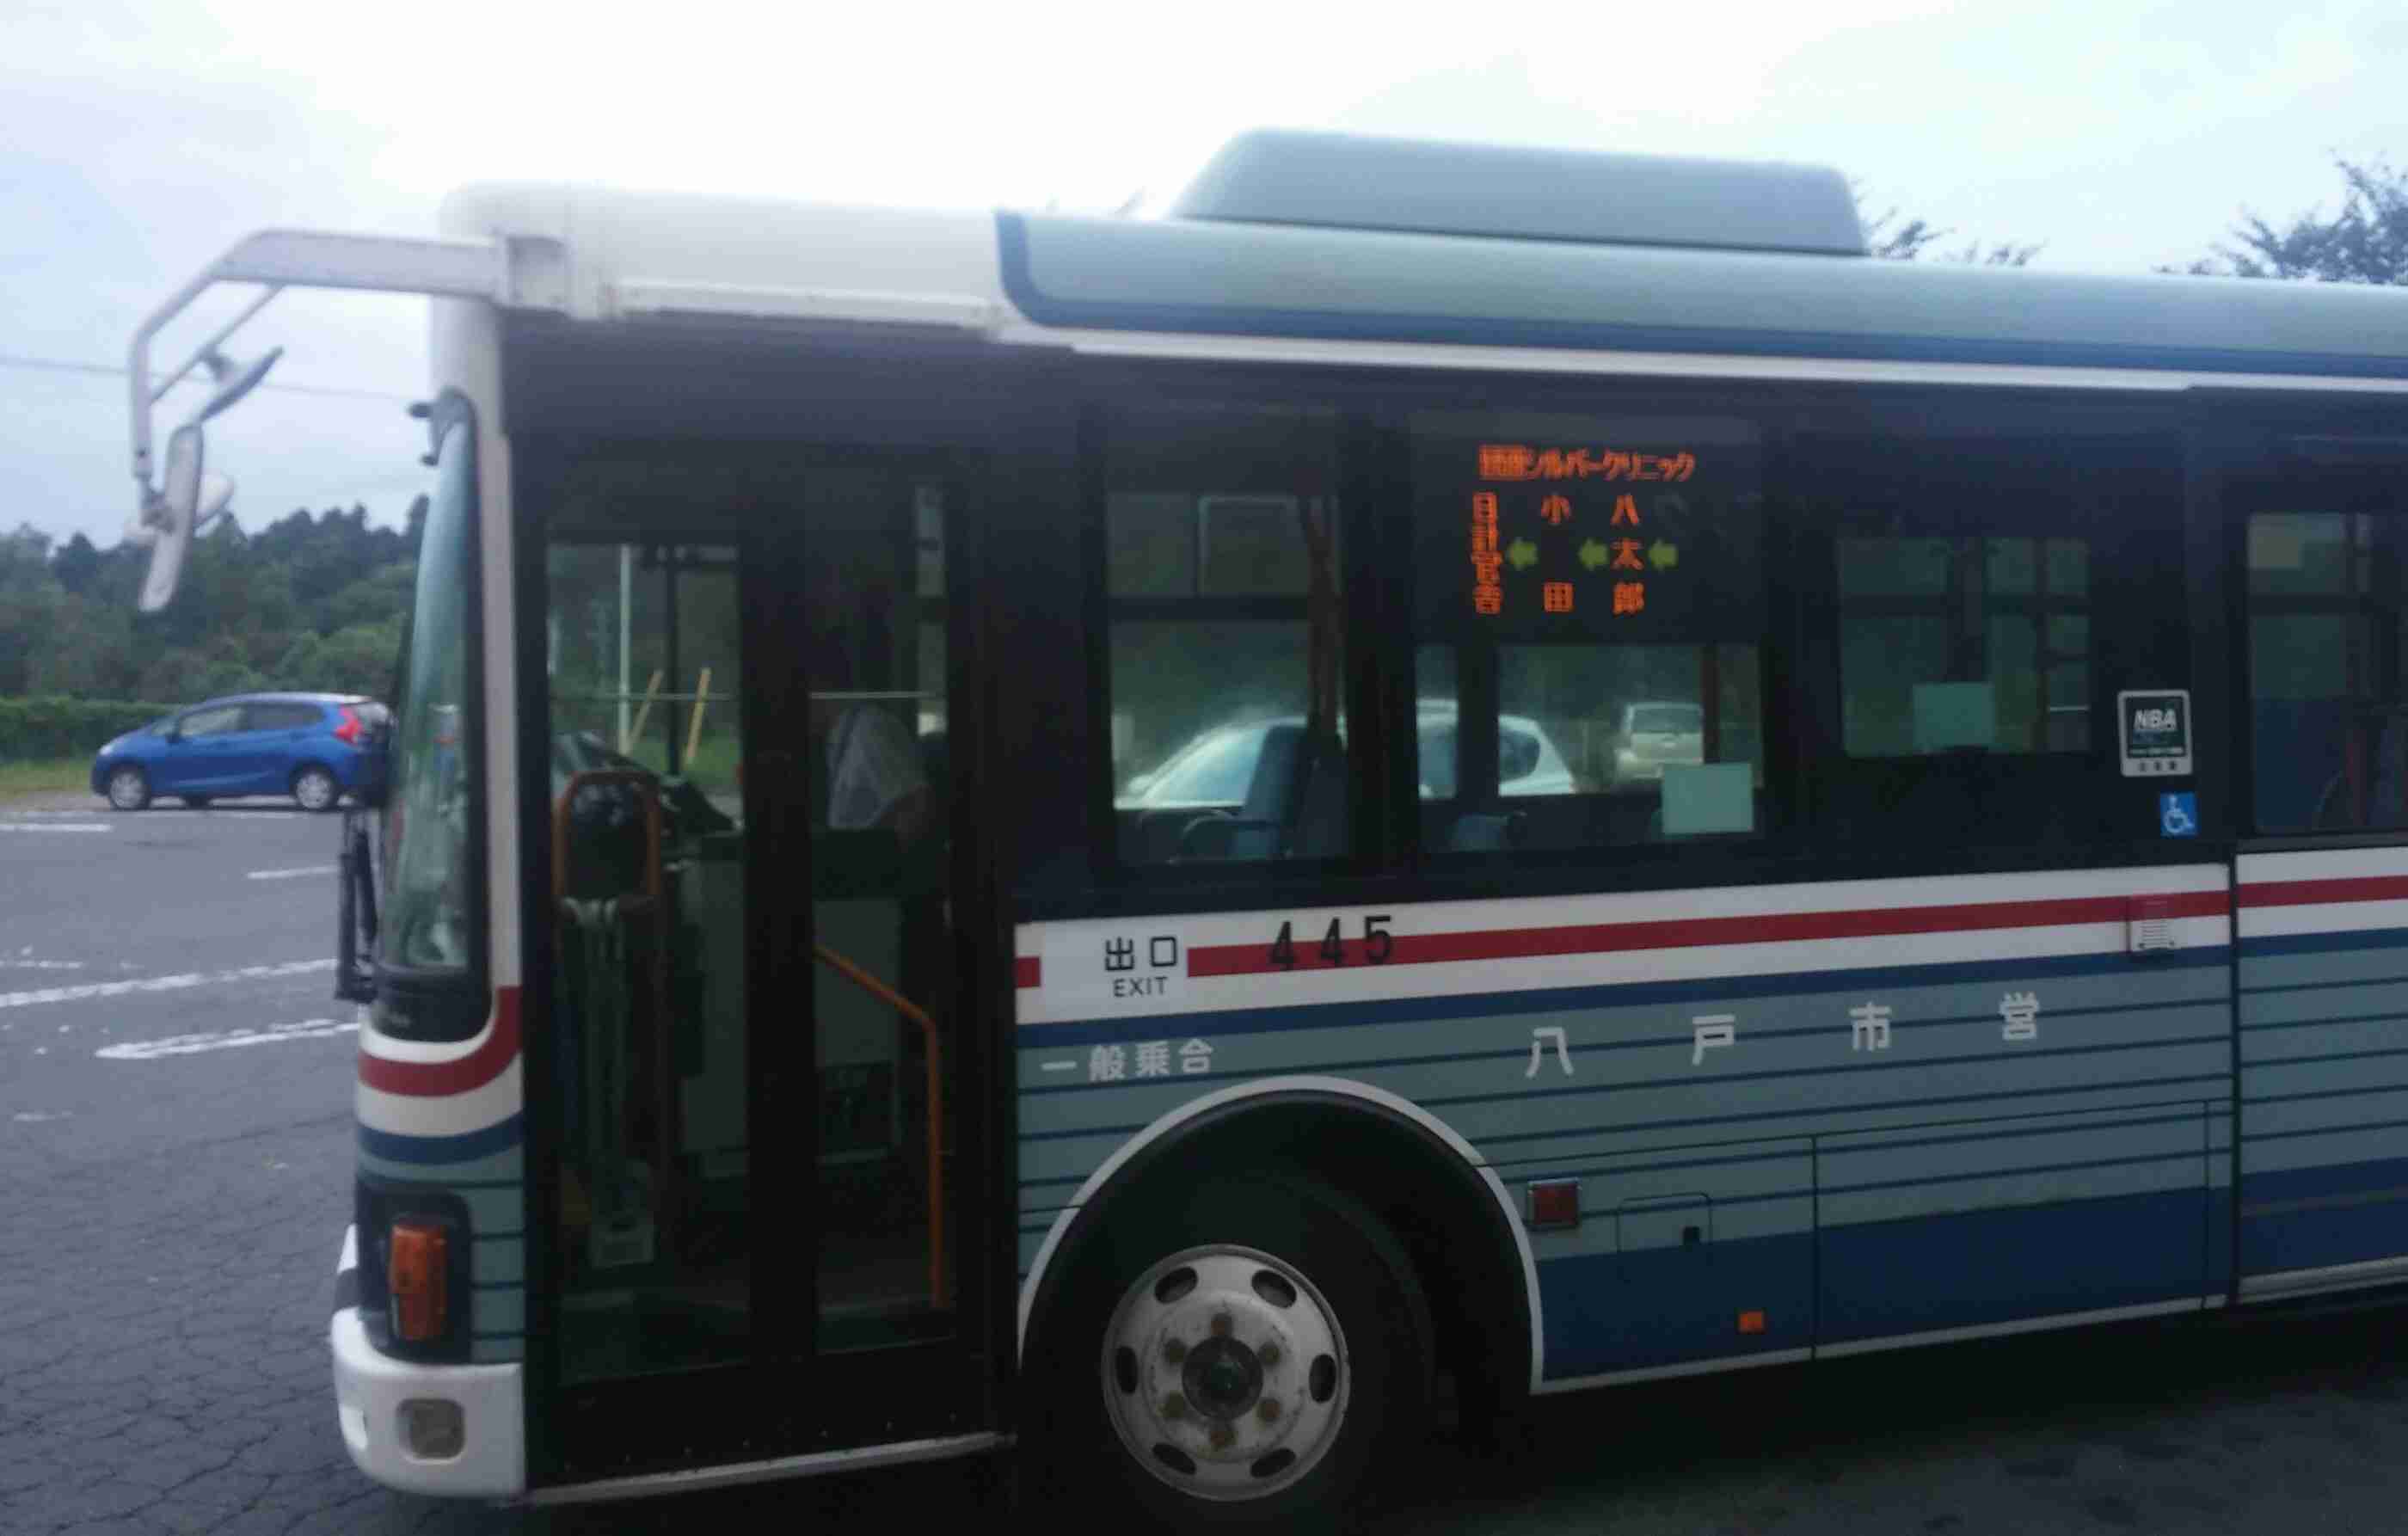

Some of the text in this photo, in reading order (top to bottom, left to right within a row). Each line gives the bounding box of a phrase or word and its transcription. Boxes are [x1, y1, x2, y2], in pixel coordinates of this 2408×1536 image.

[1105, 937, 1178, 972] 出口
[1270, 916, 1391, 969] 445
[1114, 977, 1169, 998] EXIT
[1526, 992, 2040, 1078] 八戸市営
[1041, 1038, 1213, 1081] 一般乗合
